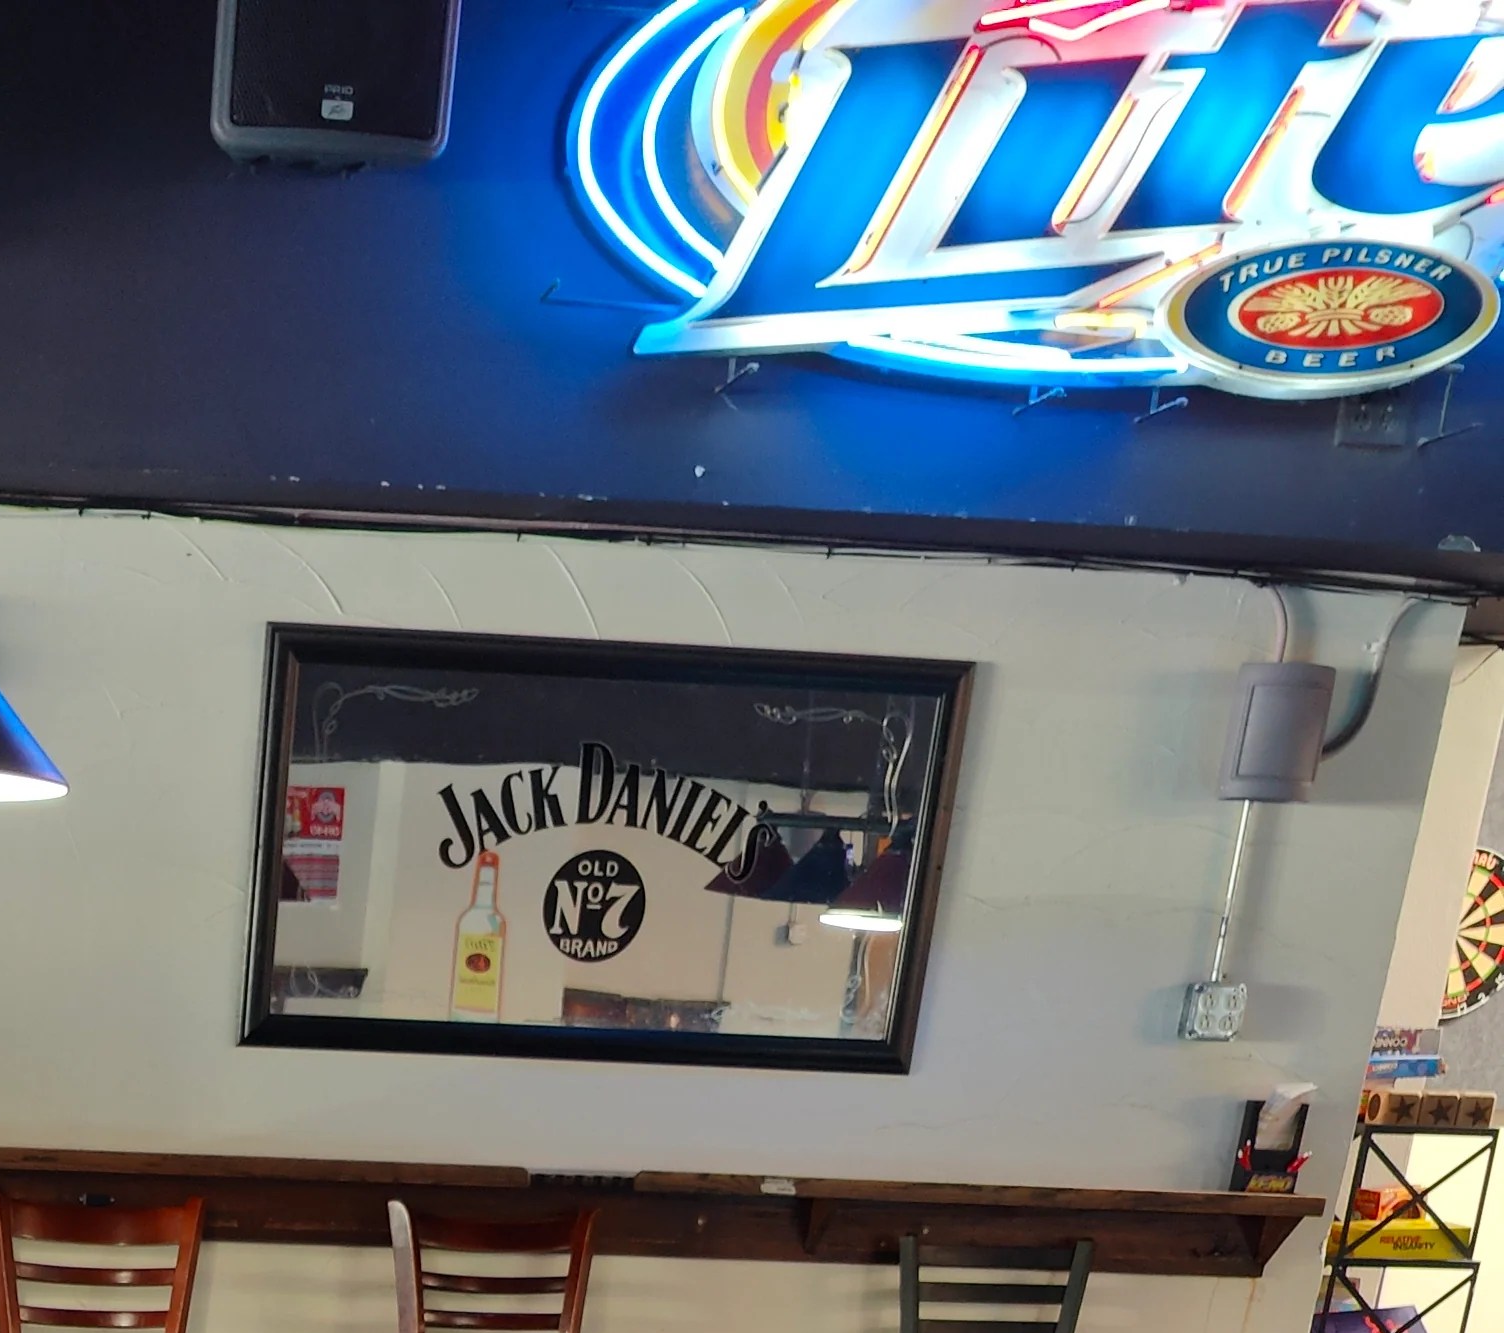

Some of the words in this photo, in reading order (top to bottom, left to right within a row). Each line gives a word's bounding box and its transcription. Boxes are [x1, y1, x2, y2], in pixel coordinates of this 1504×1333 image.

[1219, 252, 1307, 293] TRUE
[1322, 247, 1453, 281] PILSNER
[1265, 345, 1396, 368] BEER
[437, 765, 568, 869] JACK
[575, 741, 777, 884] DANIEL'S
[577, 859, 620, 878] OLD
[559, 938, 618, 959] BRAND
[1380, 1235, 1423, 1246] RELATIVE
[1392, 1240, 1436, 1251] INSANITY
